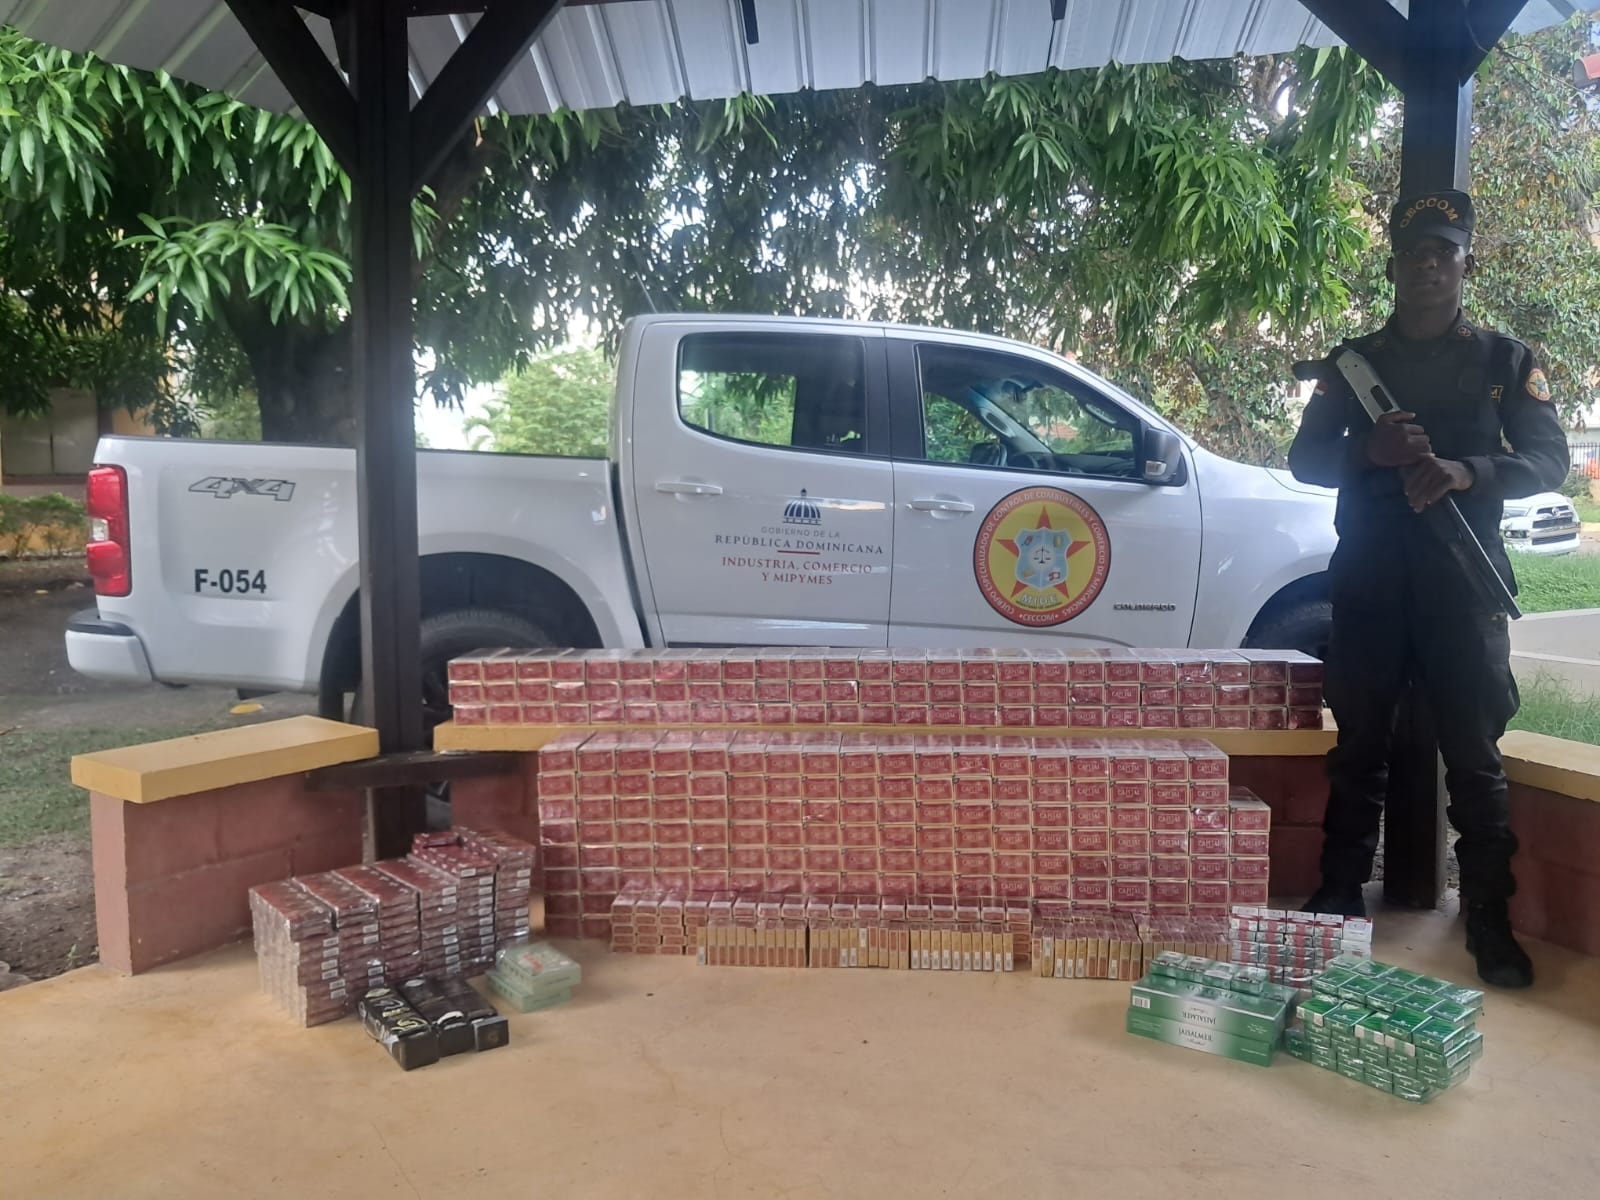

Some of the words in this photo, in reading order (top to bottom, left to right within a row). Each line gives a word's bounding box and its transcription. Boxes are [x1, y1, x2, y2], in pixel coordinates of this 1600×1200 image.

[1400, 197, 1458, 228] CECCOM
[761, 526, 809, 537] GOBIERNO
[813, 530, 825, 538] DE
[828, 530, 840, 538] LA
[796, 540, 883, 554] DOMINICANA
[722, 556, 799, 571] INDUSTRIA,
[803, 561, 872, 574] COMERCIO
[194, 568, 267, 594] F-054
[762, 572, 771, 582] Y
[773, 573, 833, 585] MIPYMES
